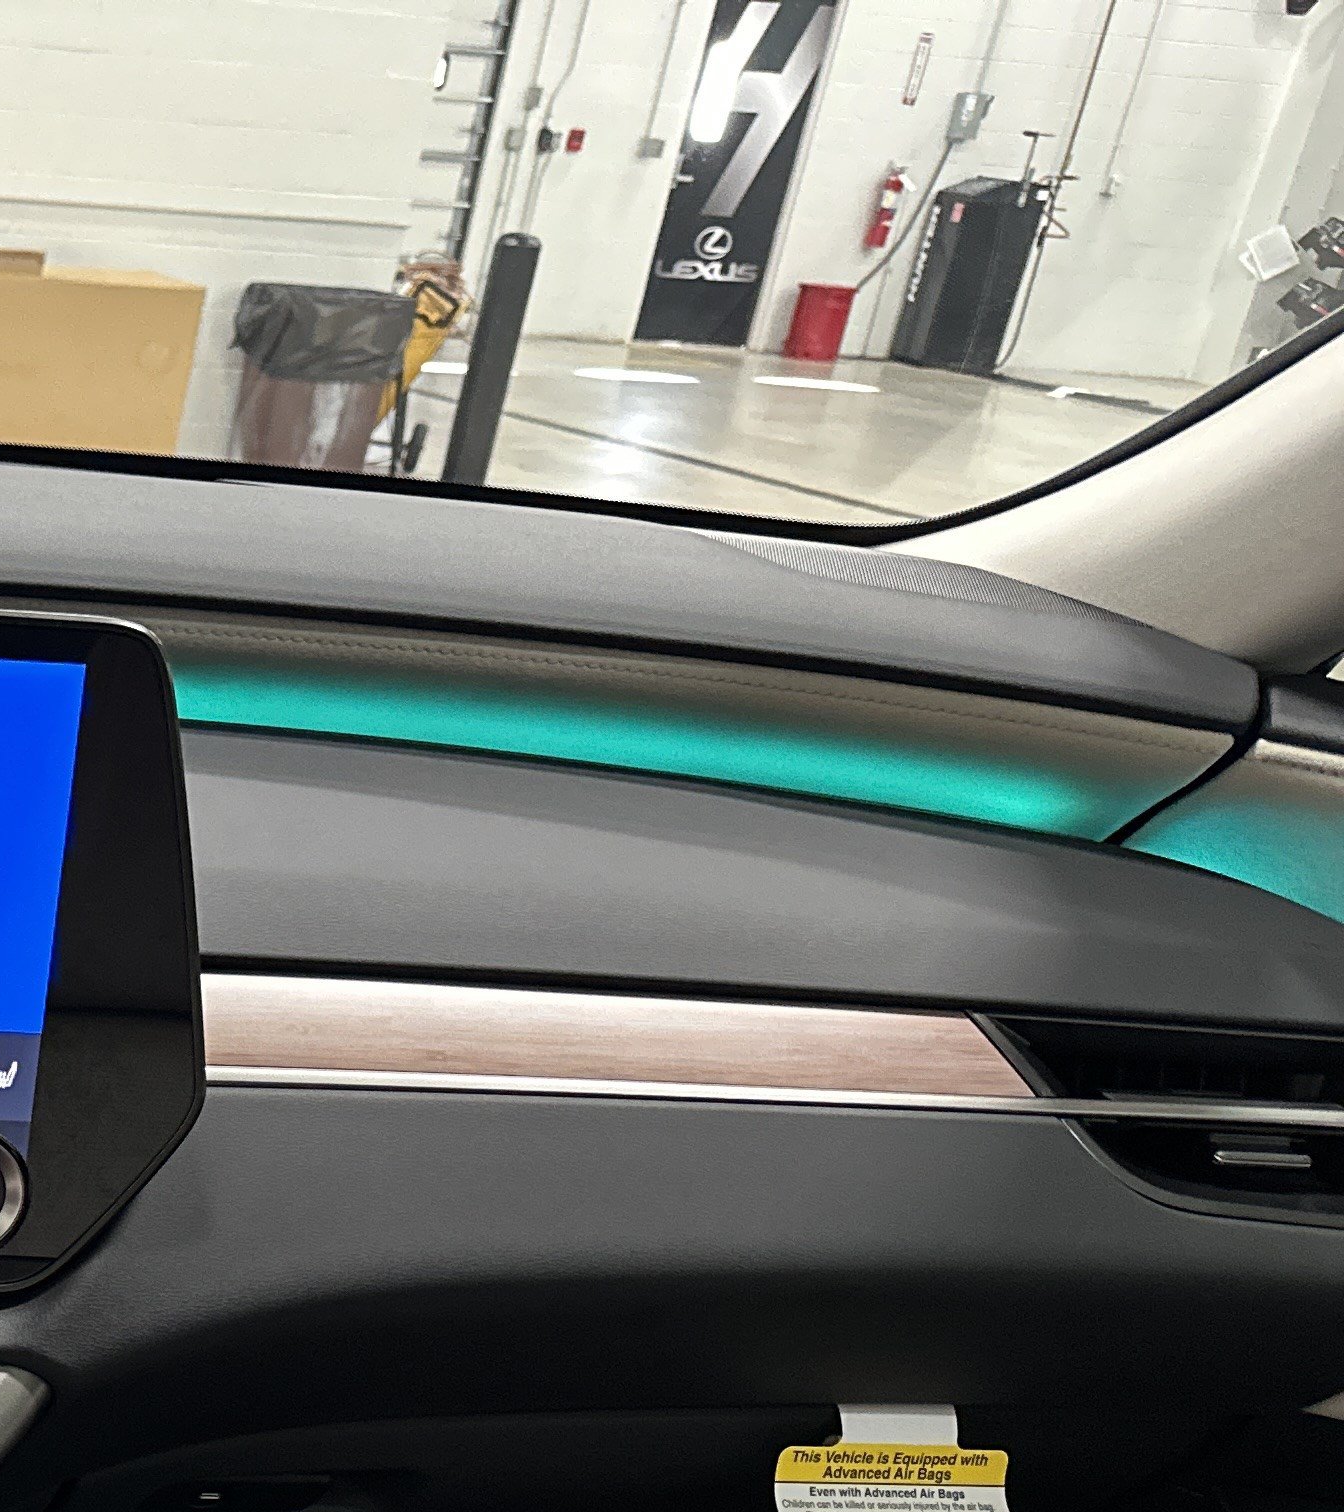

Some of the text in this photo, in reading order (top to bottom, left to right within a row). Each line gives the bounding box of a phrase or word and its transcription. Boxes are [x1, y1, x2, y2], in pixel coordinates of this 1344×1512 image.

[655, 259, 759, 283] LEXUS
[792, 1450, 989, 1469] This Vehicle is Equipped with
[822, 1465, 952, 1484] Advanced Air Bags
[809, 1486, 965, 1501] Even with Advanced Air Bags
[781, 1498, 816, 1509] Children
[816, 1501, 832, 1509] can
[833, 1500, 844, 1509] be
